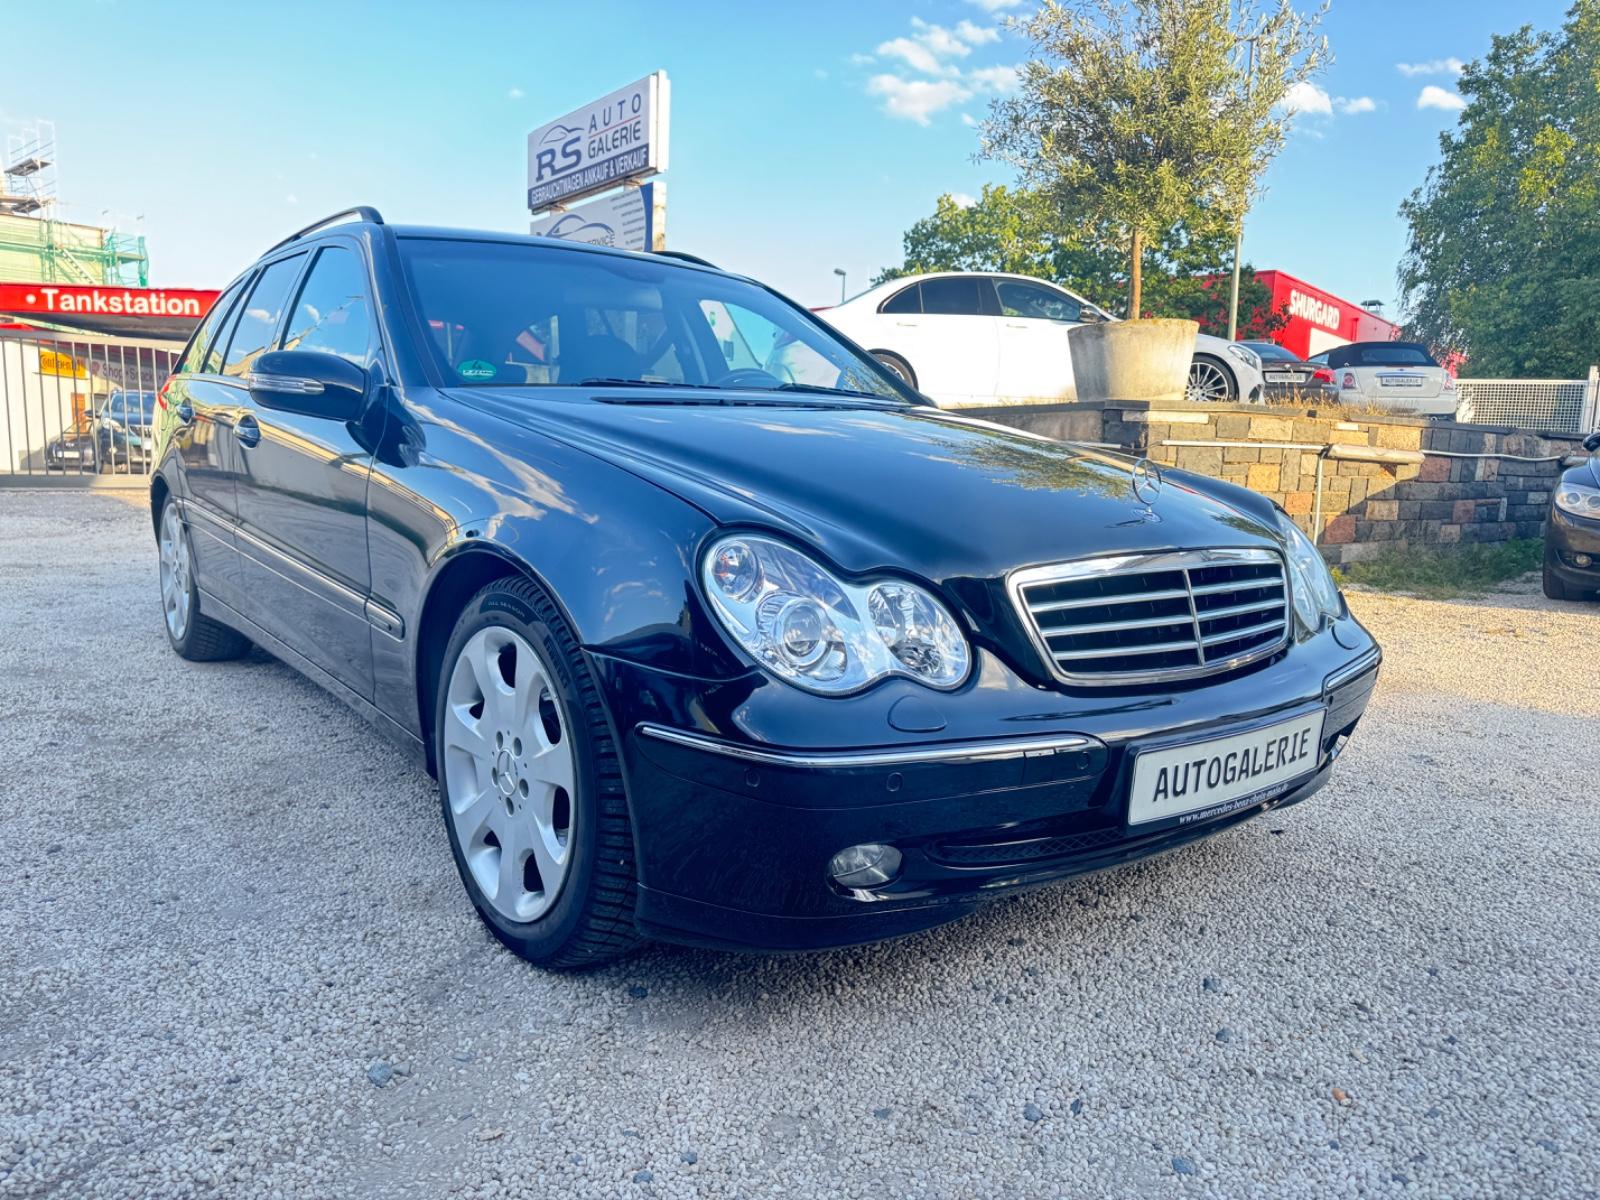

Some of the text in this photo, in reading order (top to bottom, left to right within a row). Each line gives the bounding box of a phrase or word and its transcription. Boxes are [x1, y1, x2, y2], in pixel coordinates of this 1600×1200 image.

[588, 93, 642, 134] AUTO
[536, 136, 582, 182] RS
[587, 120, 641, 159] GALERIE
[531, 174, 584, 205] GEBRAUCHTWAGEN
[584, 162, 609, 187] ANKAUF
[609, 160, 615, 176] &
[615, 149, 648, 175] VERKAUF
[41, 289, 200, 315] Tankstation
[1288, 289, 1340, 331] SHURGARD
[1152, 728, 1311, 802] AUTOGALERIE
